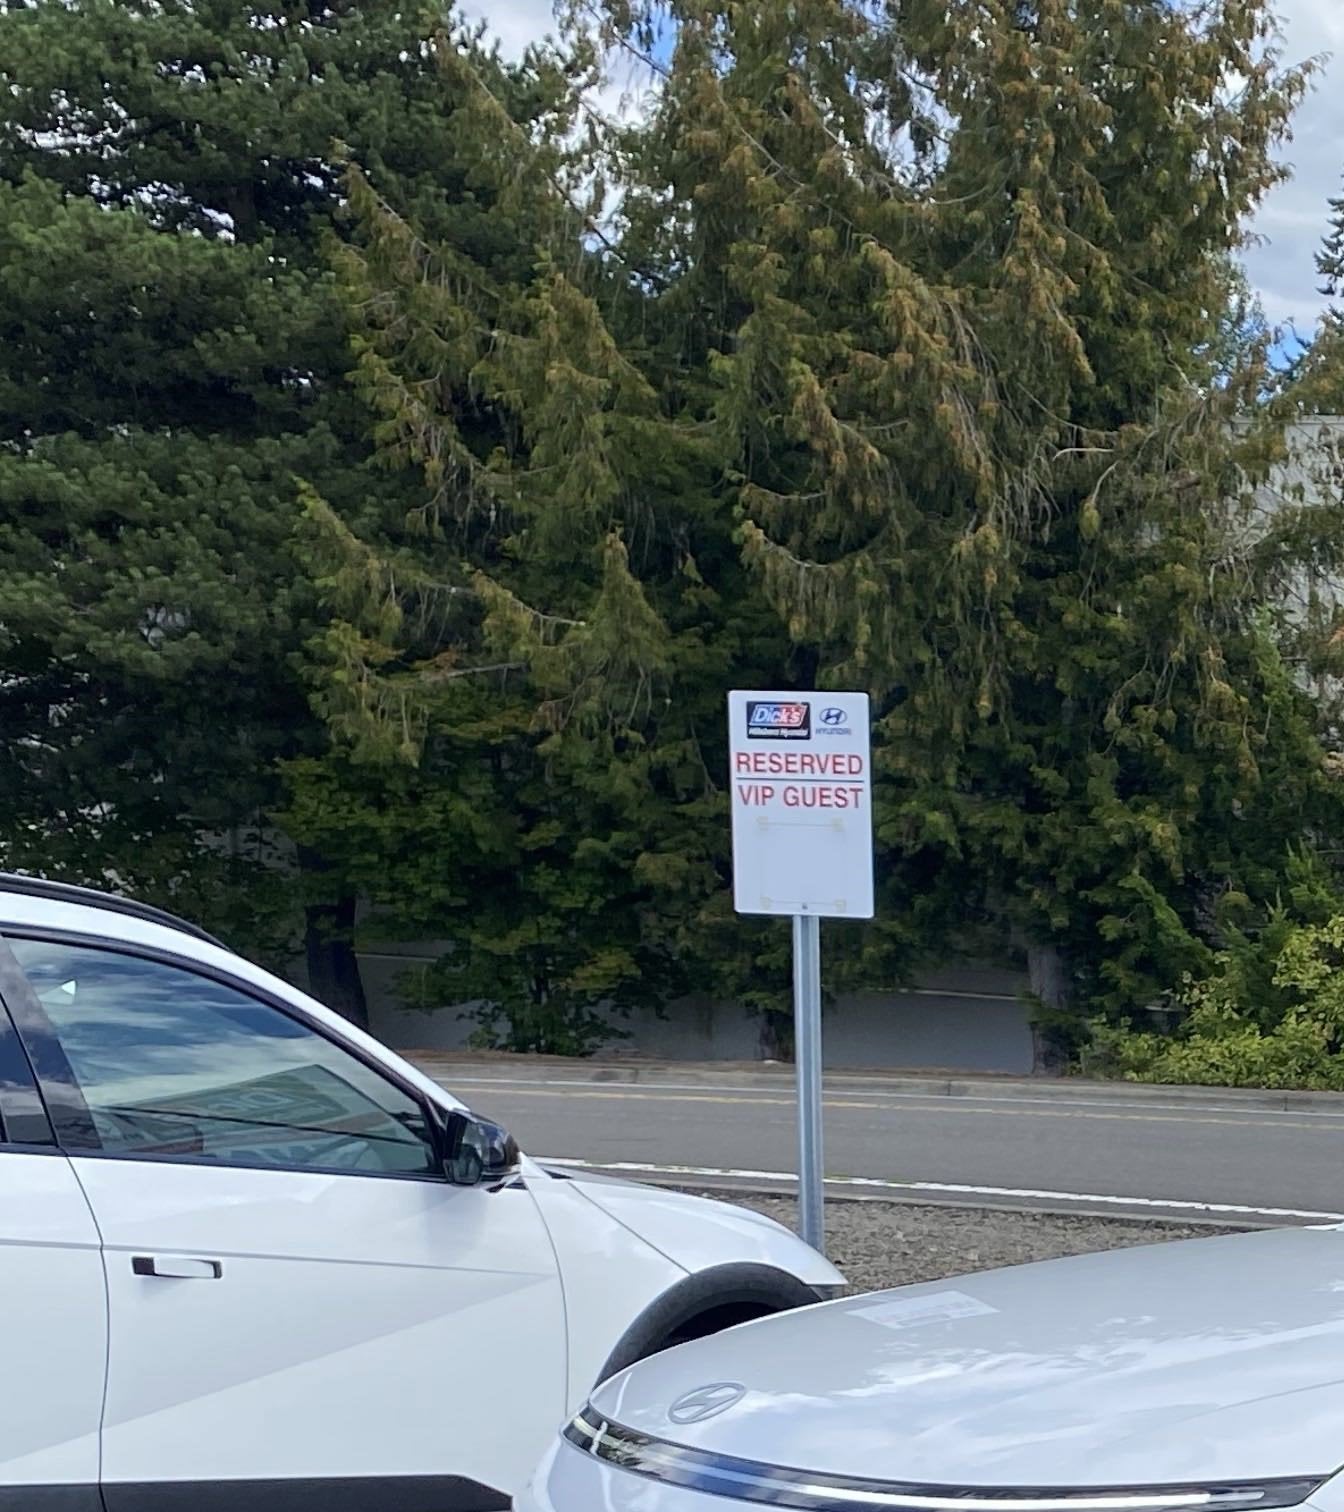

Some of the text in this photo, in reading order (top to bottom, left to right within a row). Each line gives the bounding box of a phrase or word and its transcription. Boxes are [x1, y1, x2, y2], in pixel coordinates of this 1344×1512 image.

[736, 752, 863, 775] RESERVED
[738, 785, 863, 808] VIP GUEST
